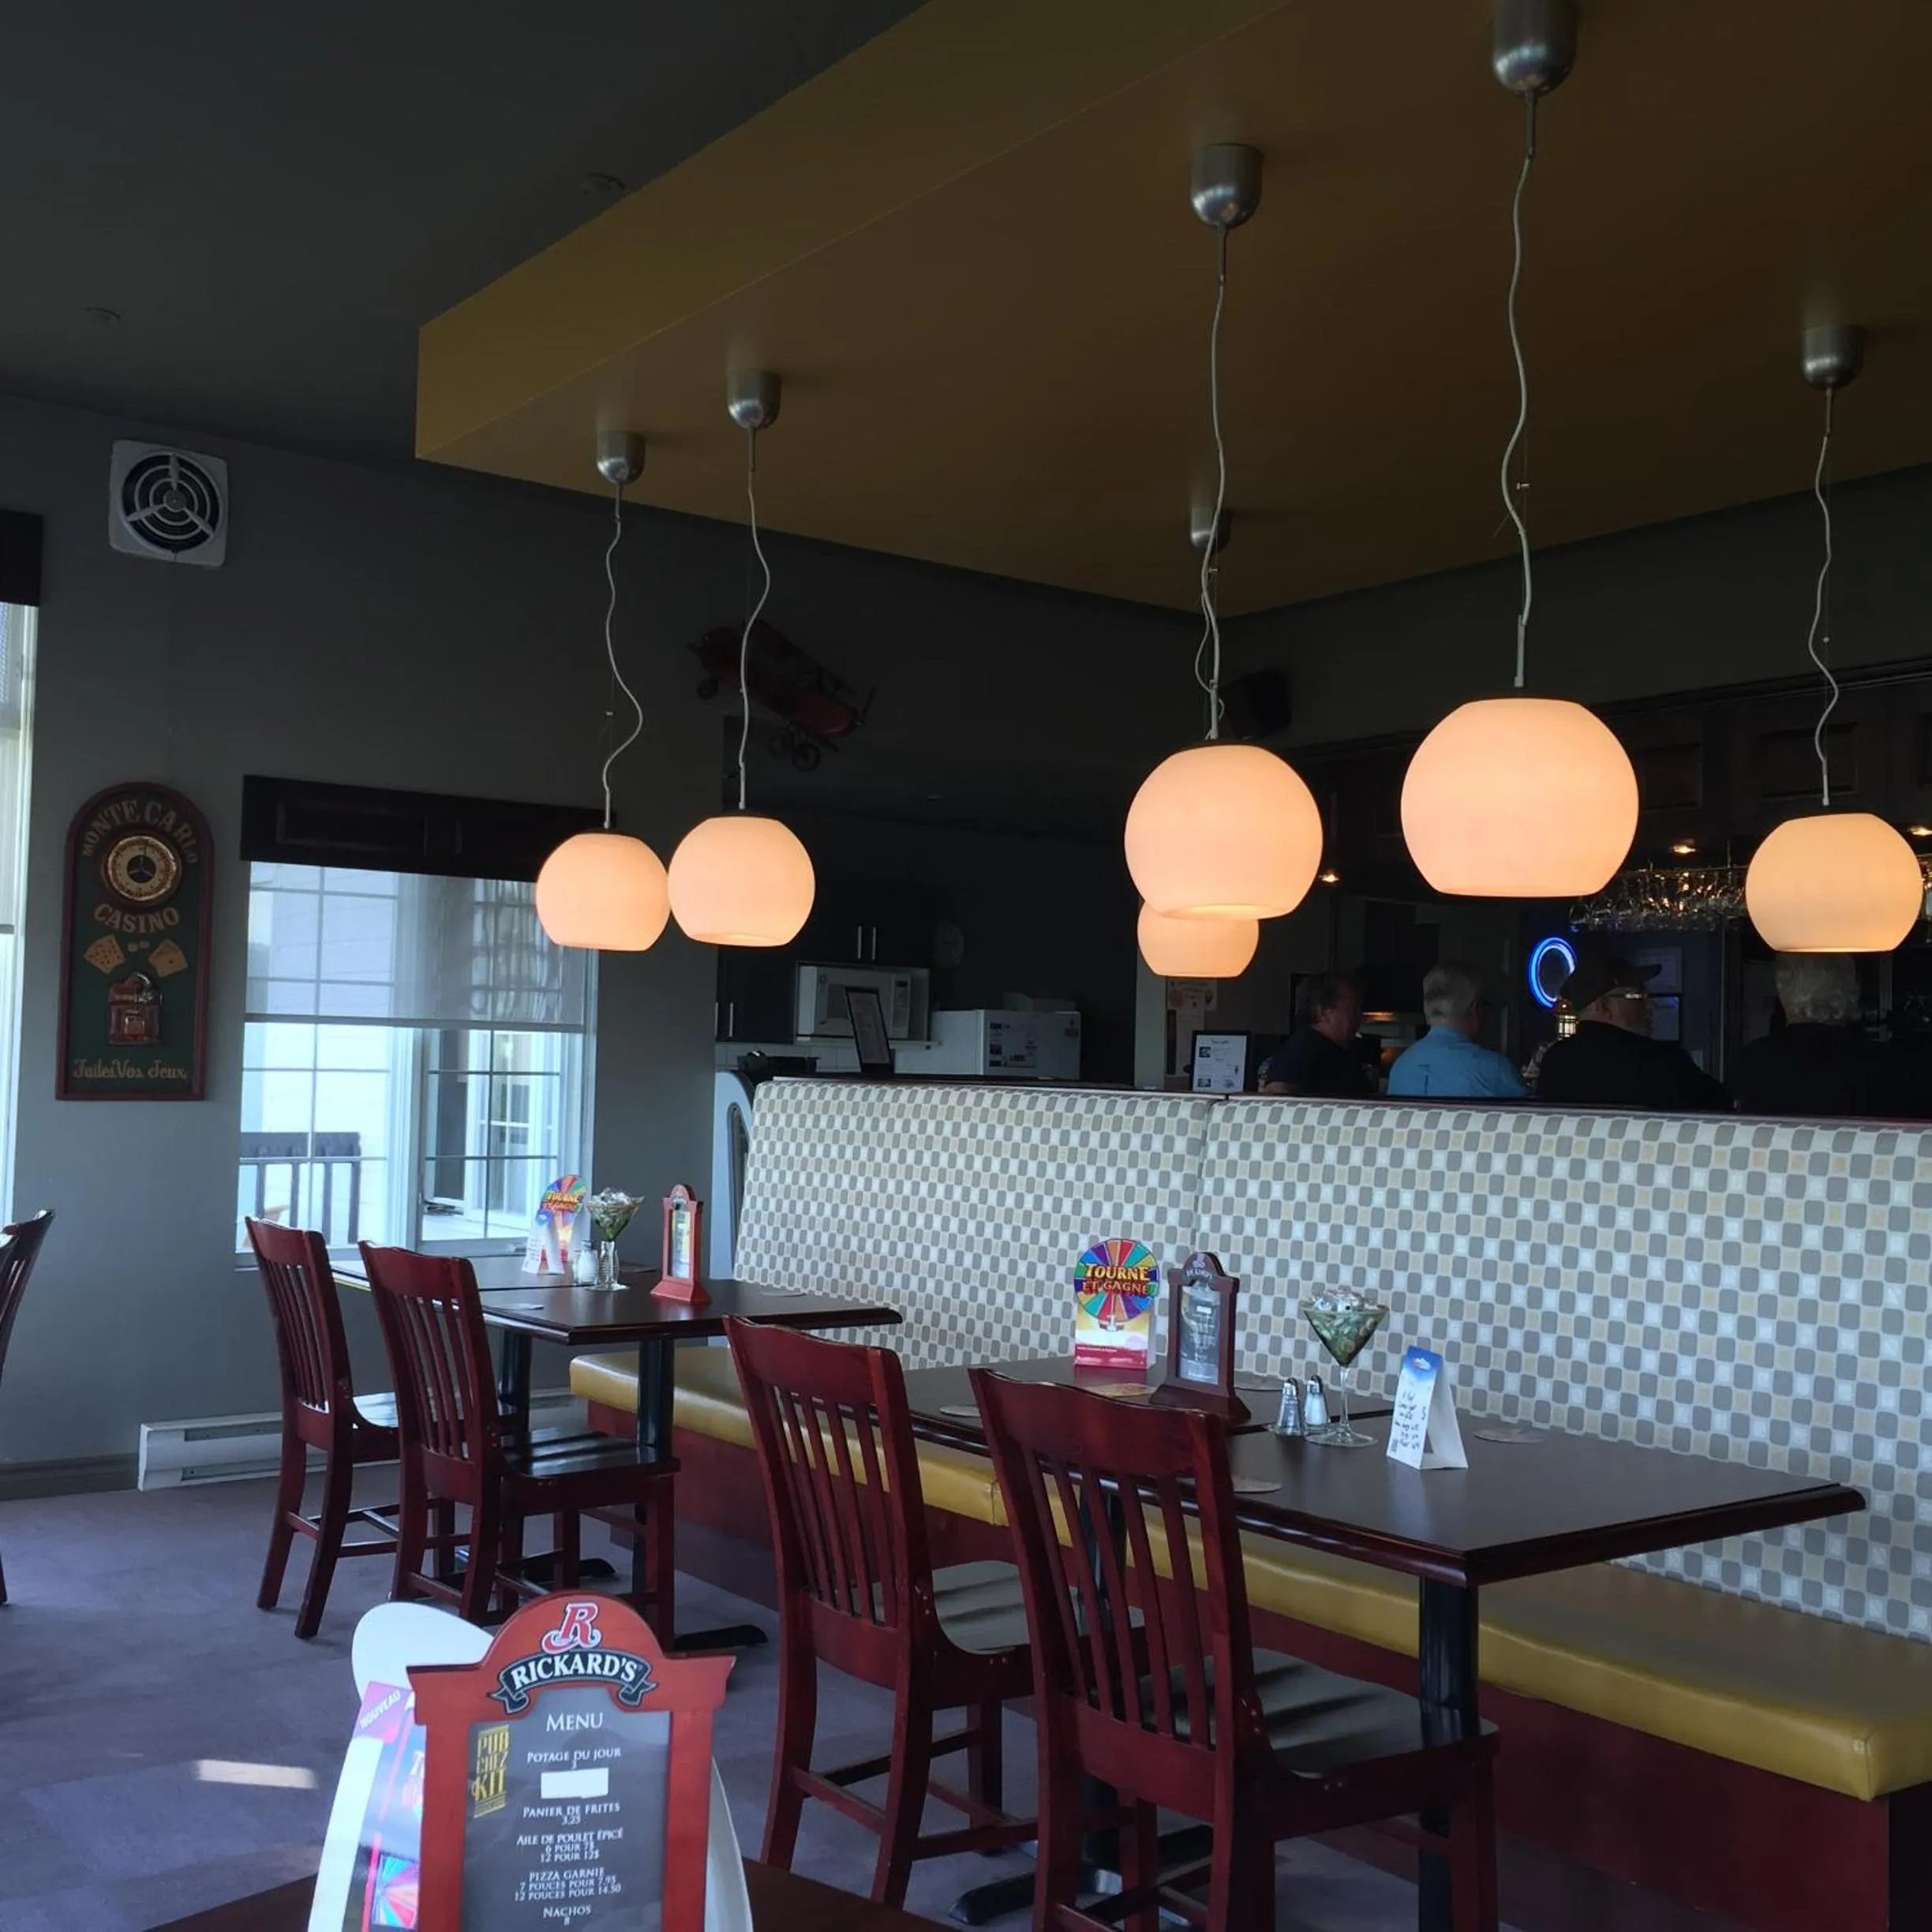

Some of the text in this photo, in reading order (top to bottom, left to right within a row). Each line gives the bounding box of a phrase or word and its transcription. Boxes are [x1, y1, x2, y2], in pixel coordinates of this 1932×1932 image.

[82, 800, 197, 864] MONTE CARLO
[94, 903, 180, 934] CASINO
[1084, 1264, 1151, 1281] TOURNE
[1103, 1280, 1150, 1295] GAGNE
[511, 1653, 638, 1690] RICKARD'S
[359, 1689, 401, 1730] NOUVEAU
[545, 1712, 605, 1732] MENU
[526, 1747, 622, 1764] POTAGE DU JOUR
[523, 1801, 621, 1818] PANIER DE FRITES
[517, 1833, 539, 1846] AILE
[541, 1833, 554, 1845] DE
[557, 1830, 595, 1844] POULET
[554, 1843, 582, 1853] POUR
[554, 1852, 581, 1862] POUR
[529, 1870, 560, 1882] PIZZA
[569, 1878, 595, 1889] POUR
[569, 1887, 595, 1898] POUR
[543, 1904, 592, 1919] NACHOS
